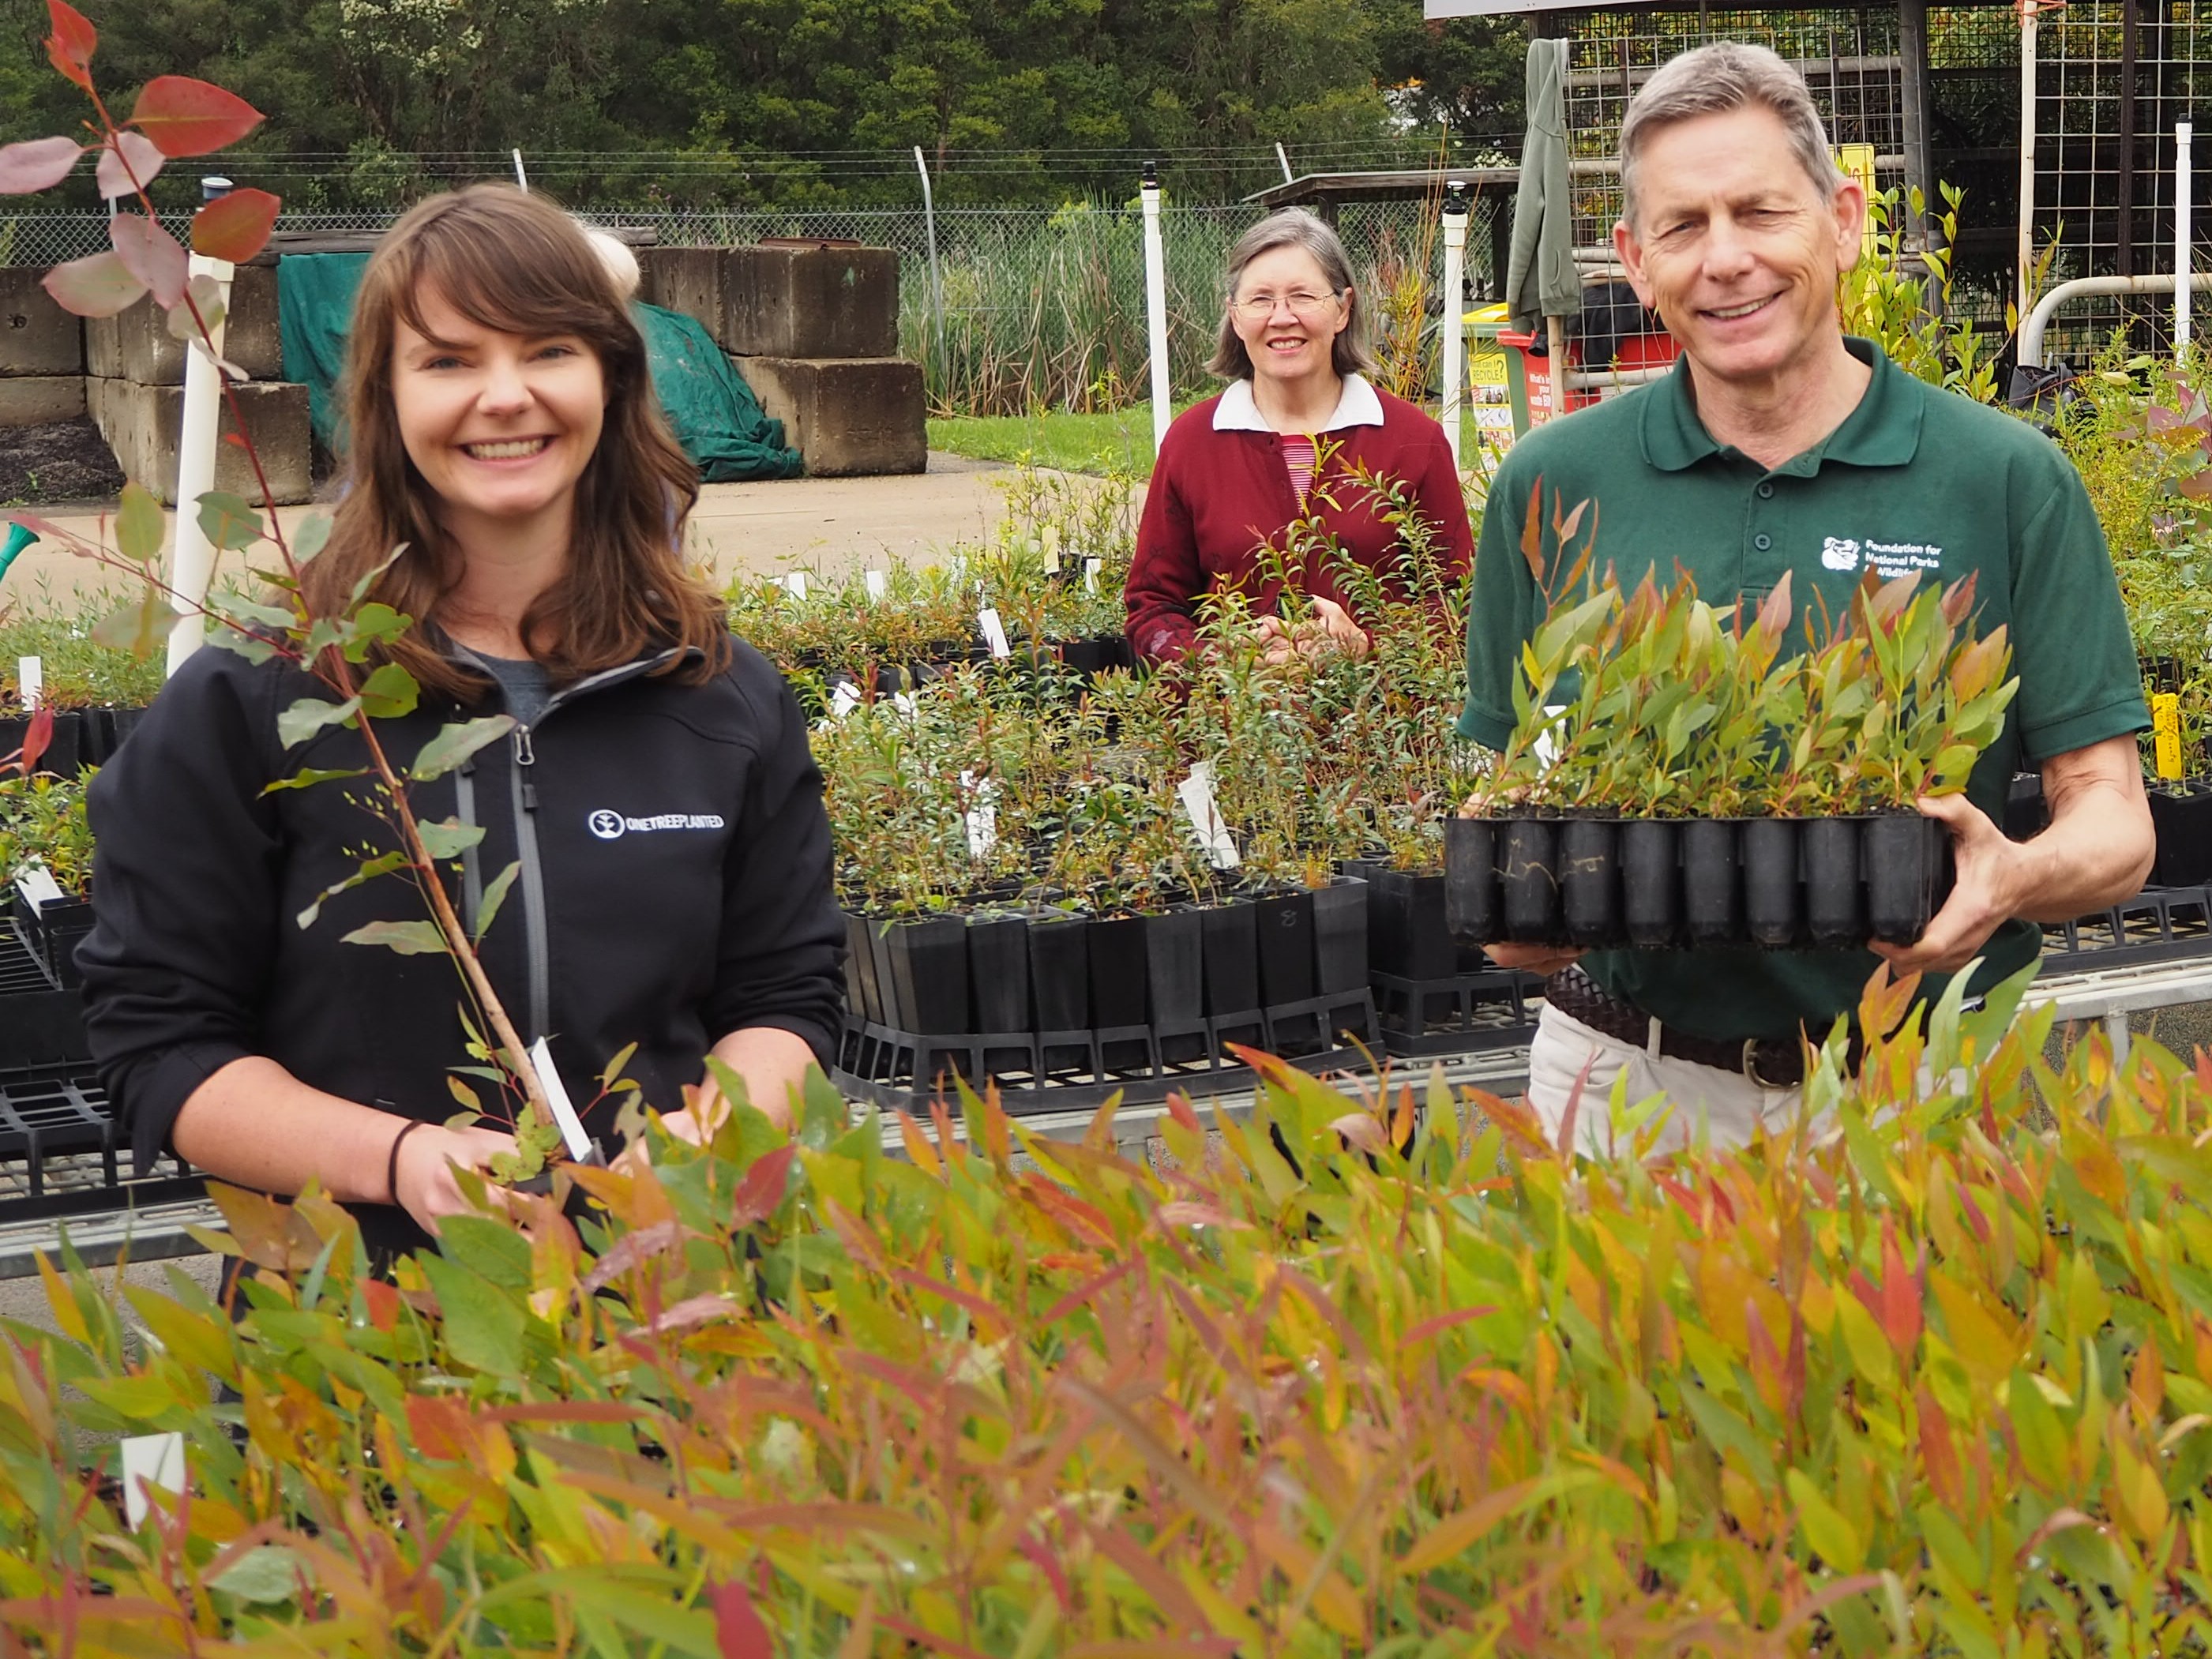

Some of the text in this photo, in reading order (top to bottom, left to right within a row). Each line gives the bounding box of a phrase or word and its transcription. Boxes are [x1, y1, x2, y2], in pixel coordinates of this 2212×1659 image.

[1473, 370, 1500, 381] RECYCLE
[1866, 539, 1942, 555] Foundation for
[1865, 552, 1939, 567] National Parks
[626, 814, 724, 831] ONETREEPLANTED
